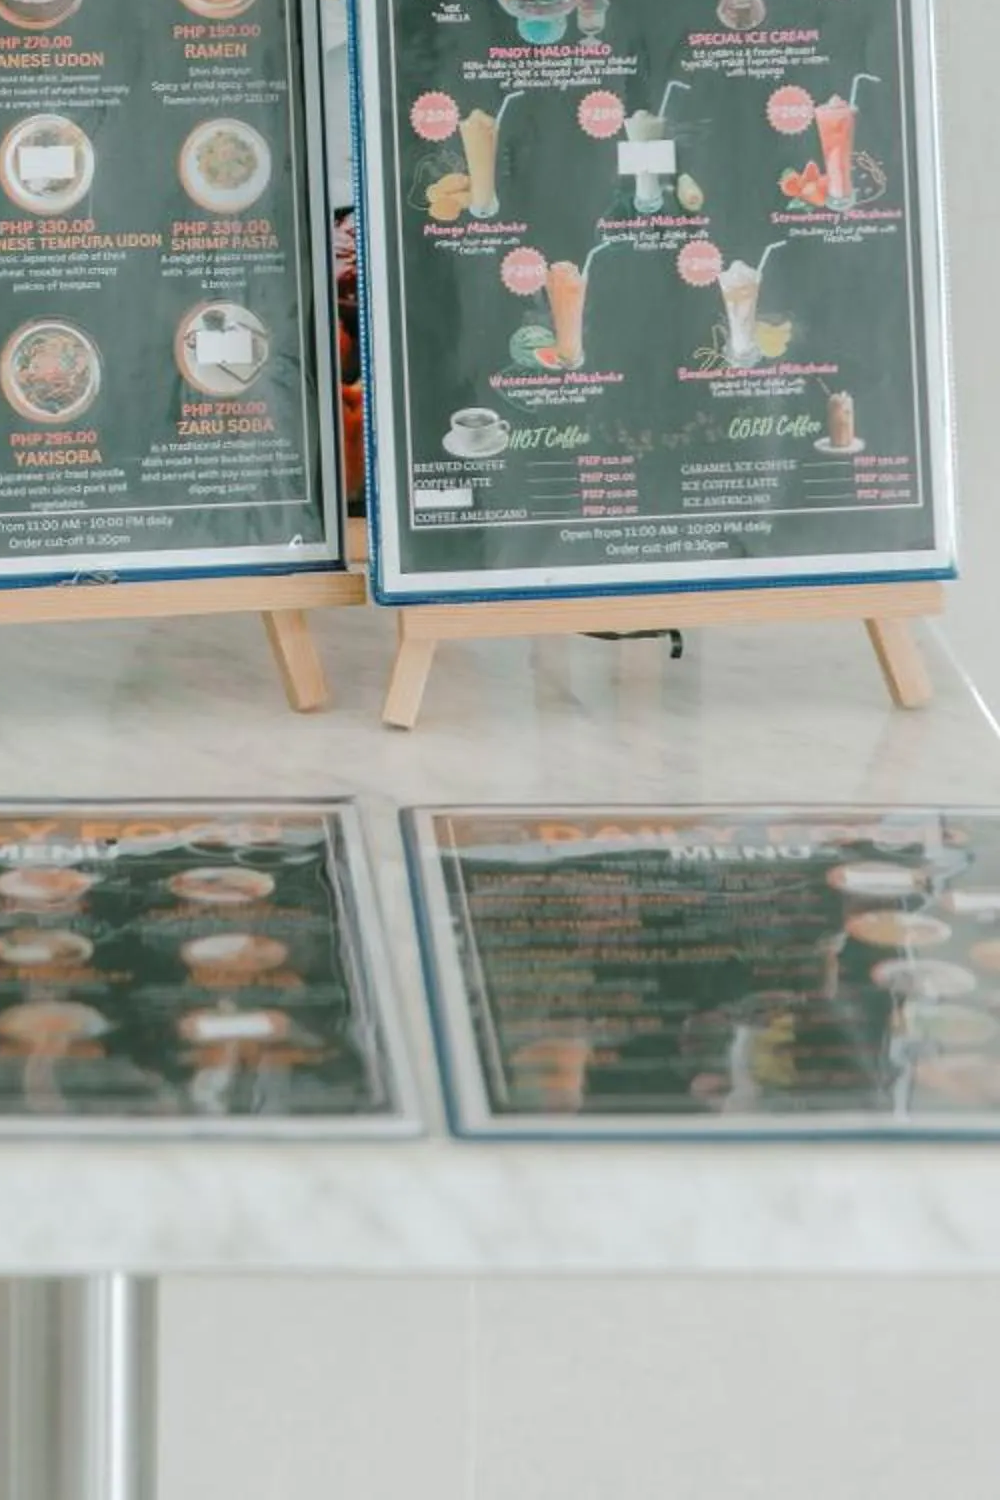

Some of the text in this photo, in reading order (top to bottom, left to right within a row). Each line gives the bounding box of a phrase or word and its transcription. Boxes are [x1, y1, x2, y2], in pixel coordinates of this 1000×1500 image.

[172, 23, 207, 40] PHP
[687, 29, 820, 46] SPECIAL ICE CREAM
[54, 50, 106, 68] UDON
[184, 42, 248, 59] RAMEN
[0, 219, 35, 236] PHP
[172, 219, 208, 237] PHP
[39, 233, 113, 252] TEMPURA
[115, 231, 163, 249] UDON
[171, 234, 279, 252] SHRIMP PASTA
[181, 402, 213, 417] PHP
[176, 417, 276, 436] ZARU SOBA
[776, 413, 822, 439] Coffee
[9, 432, 42, 448] PHP
[545, 424, 592, 450] Coffee
[13, 449, 104, 468] YAKISOBA
[27, 518, 60, 532] 11:00
[669, 844, 813, 861] MENU
